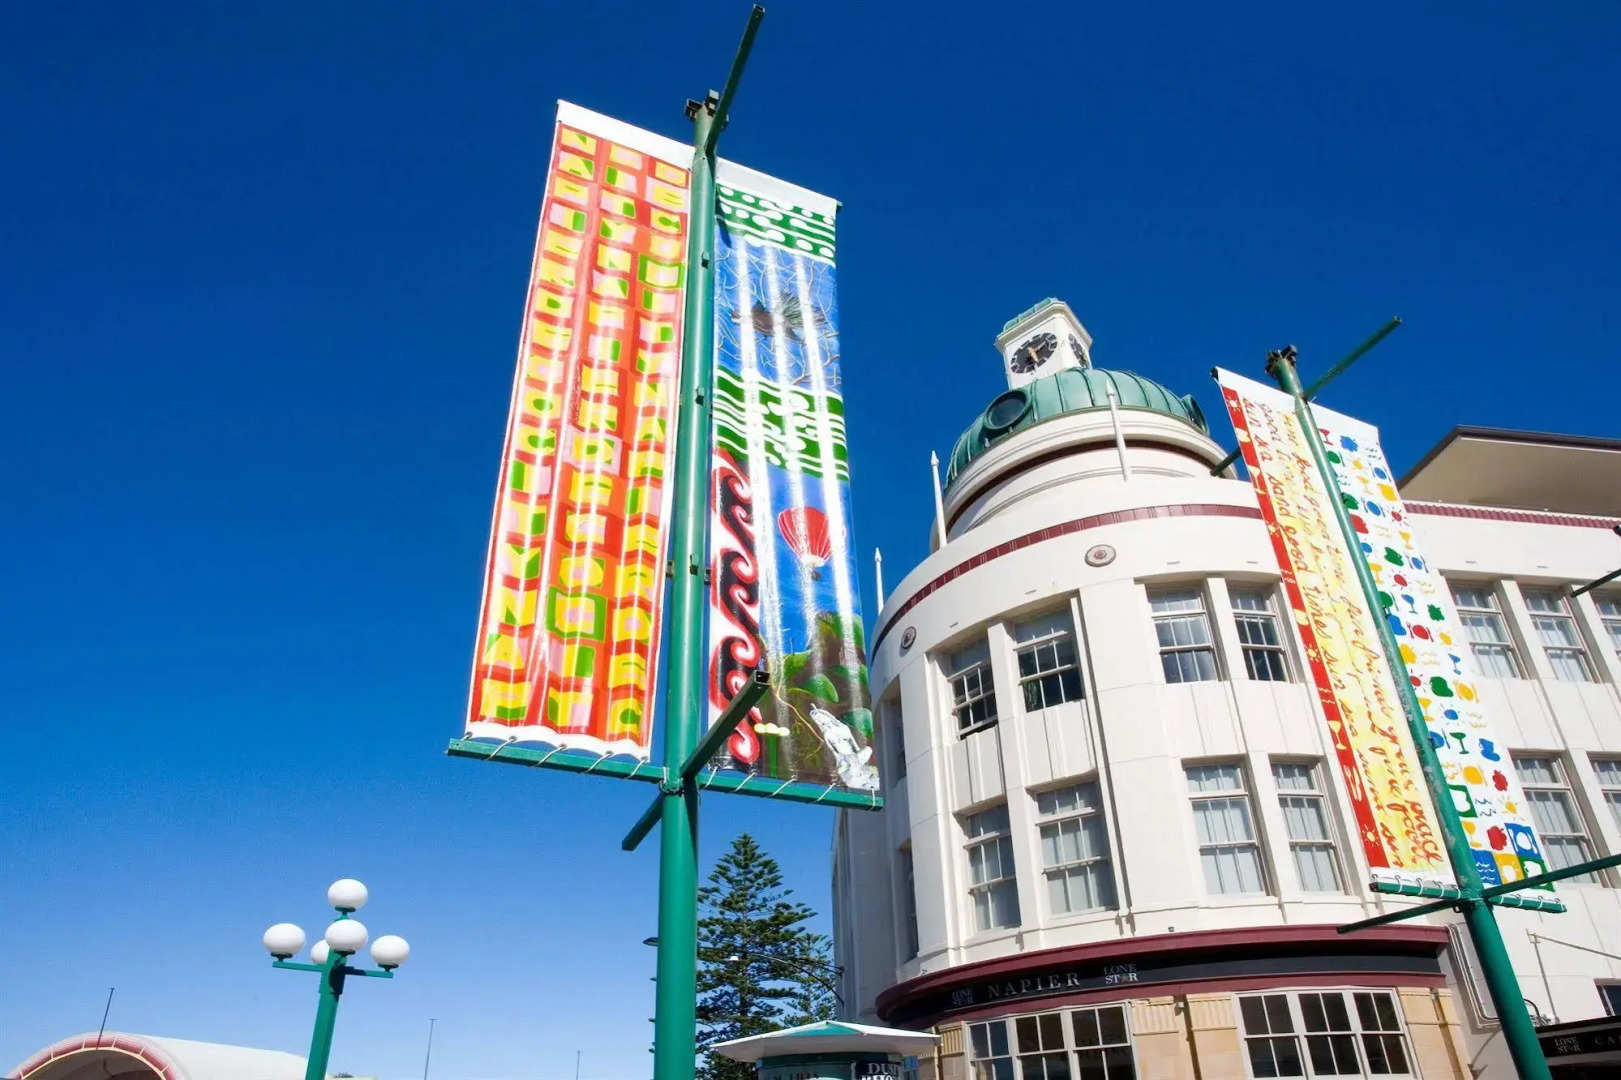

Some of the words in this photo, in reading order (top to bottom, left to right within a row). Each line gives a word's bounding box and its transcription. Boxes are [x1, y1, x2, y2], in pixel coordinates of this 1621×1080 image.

[1103, 963, 1138, 976] LONE
[987, 972, 1081, 999] NAPIER
[1554, 1036, 1579, 1047] LONE
